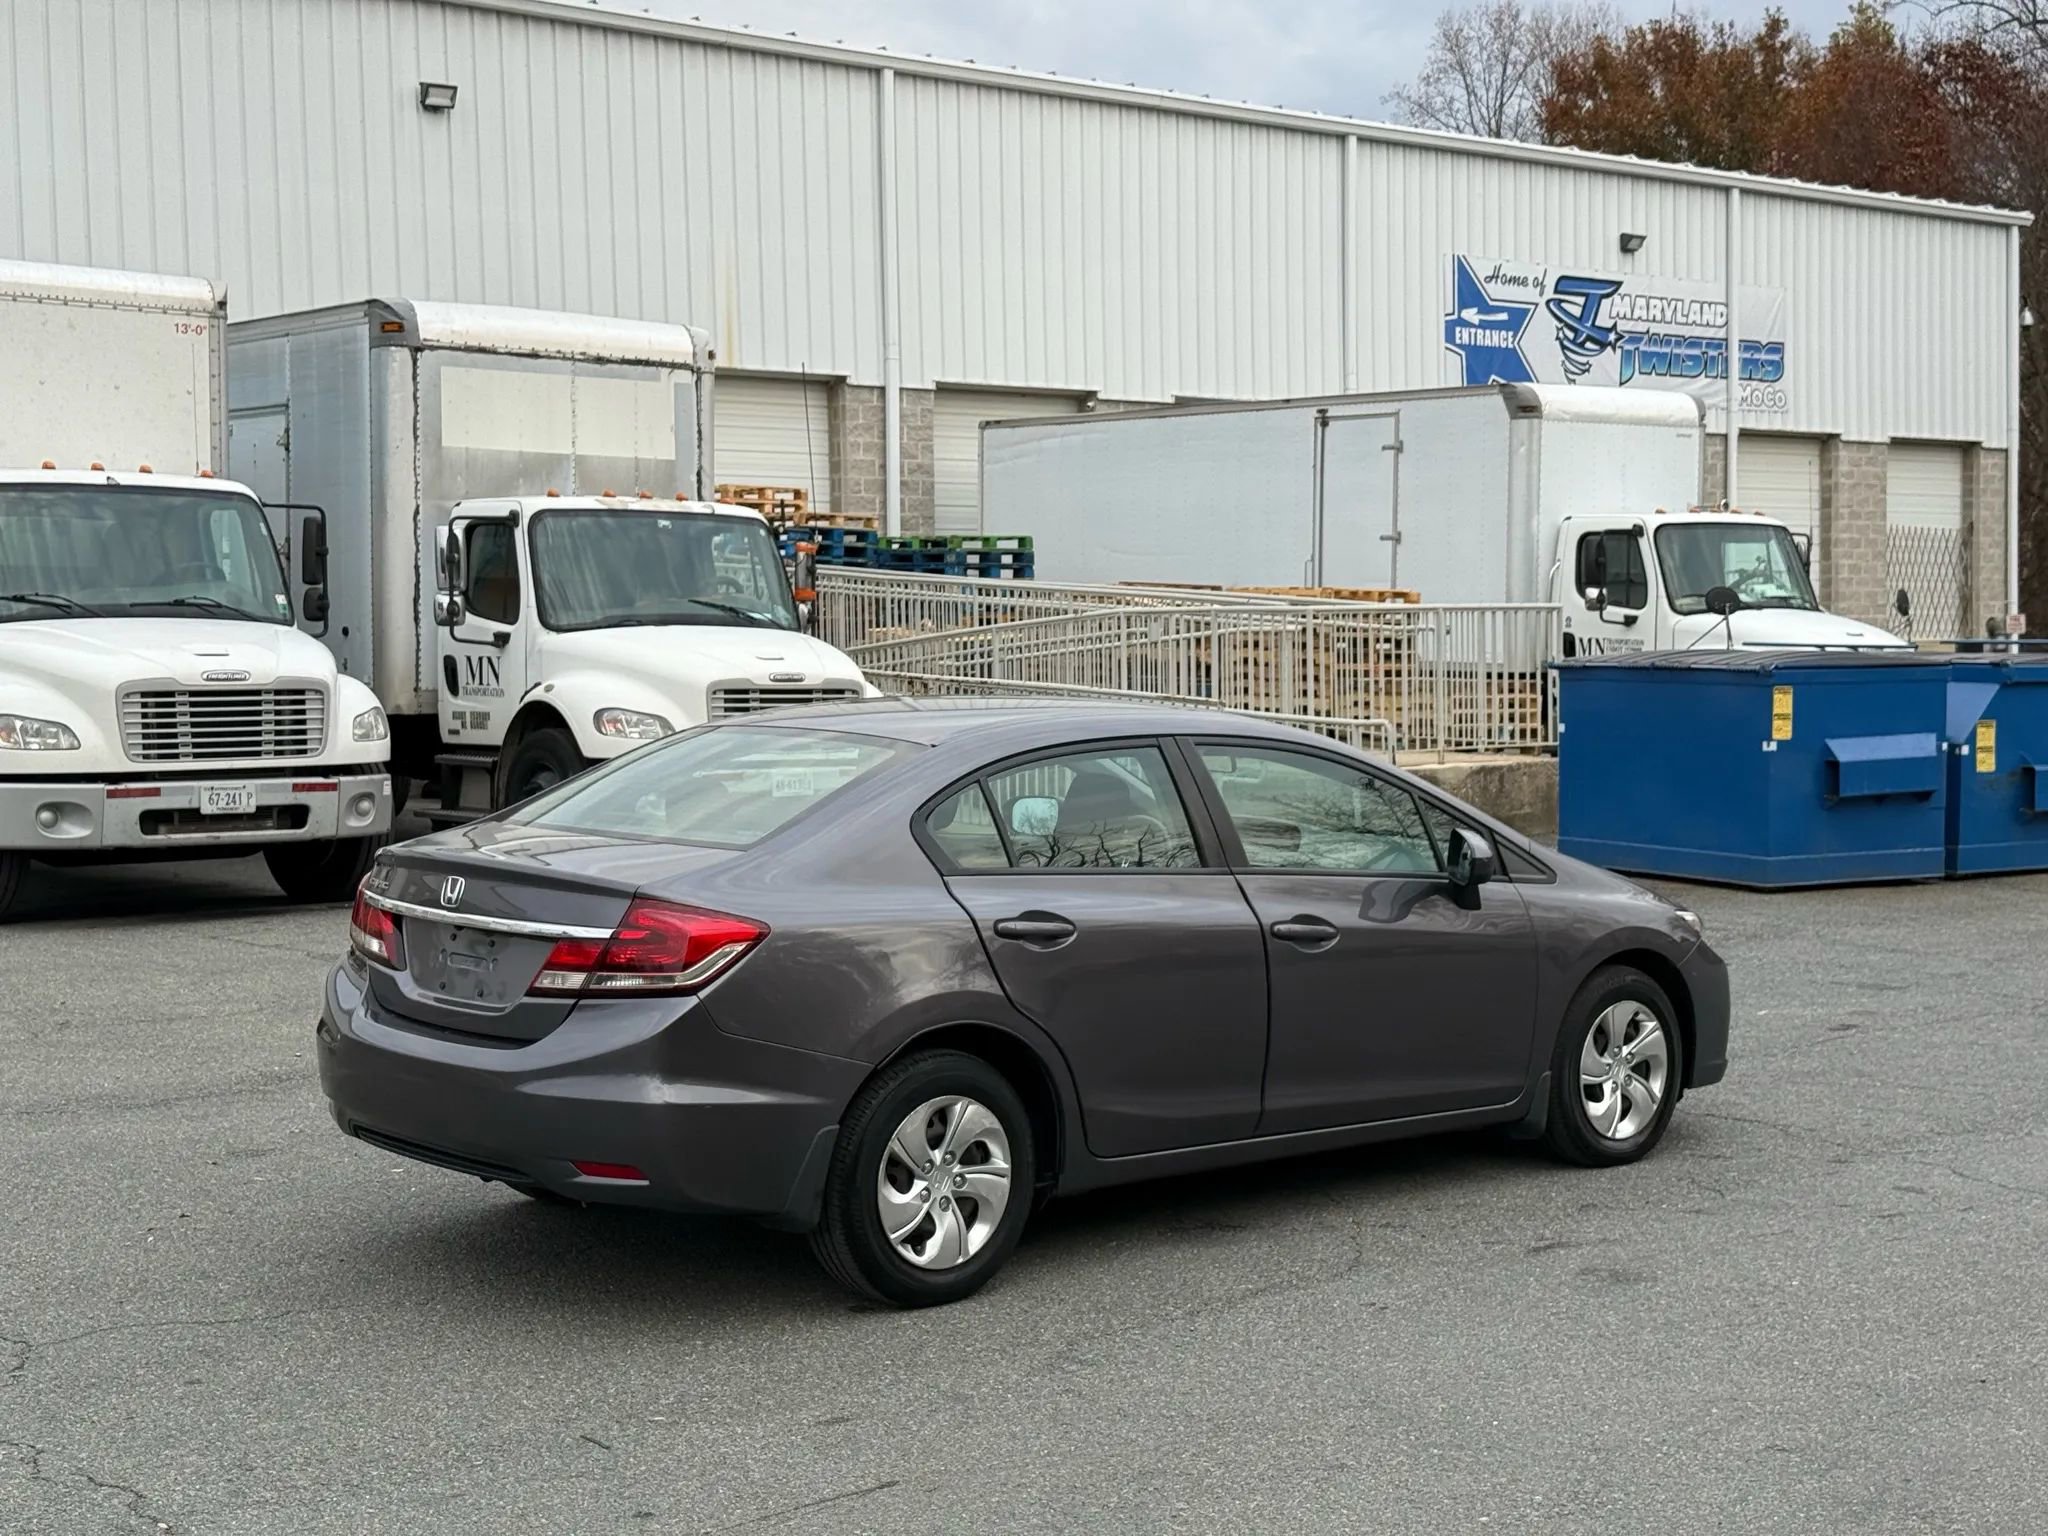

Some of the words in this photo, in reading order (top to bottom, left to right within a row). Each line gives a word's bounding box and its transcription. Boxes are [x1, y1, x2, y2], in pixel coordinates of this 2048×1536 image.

[1484, 264, 1528, 288] Home
[1533, 268, 1547, 297] of
[1609, 293, 1728, 328] MARYLAND
[1455, 326, 1514, 348] ENTRANCE
[1738, 383, 1787, 409] MoCo
[1579, 637, 1606, 656] MN
[464, 655, 501, 687] MN
[208, 792, 242, 806] 67-241
[247, 791, 254, 807] P
